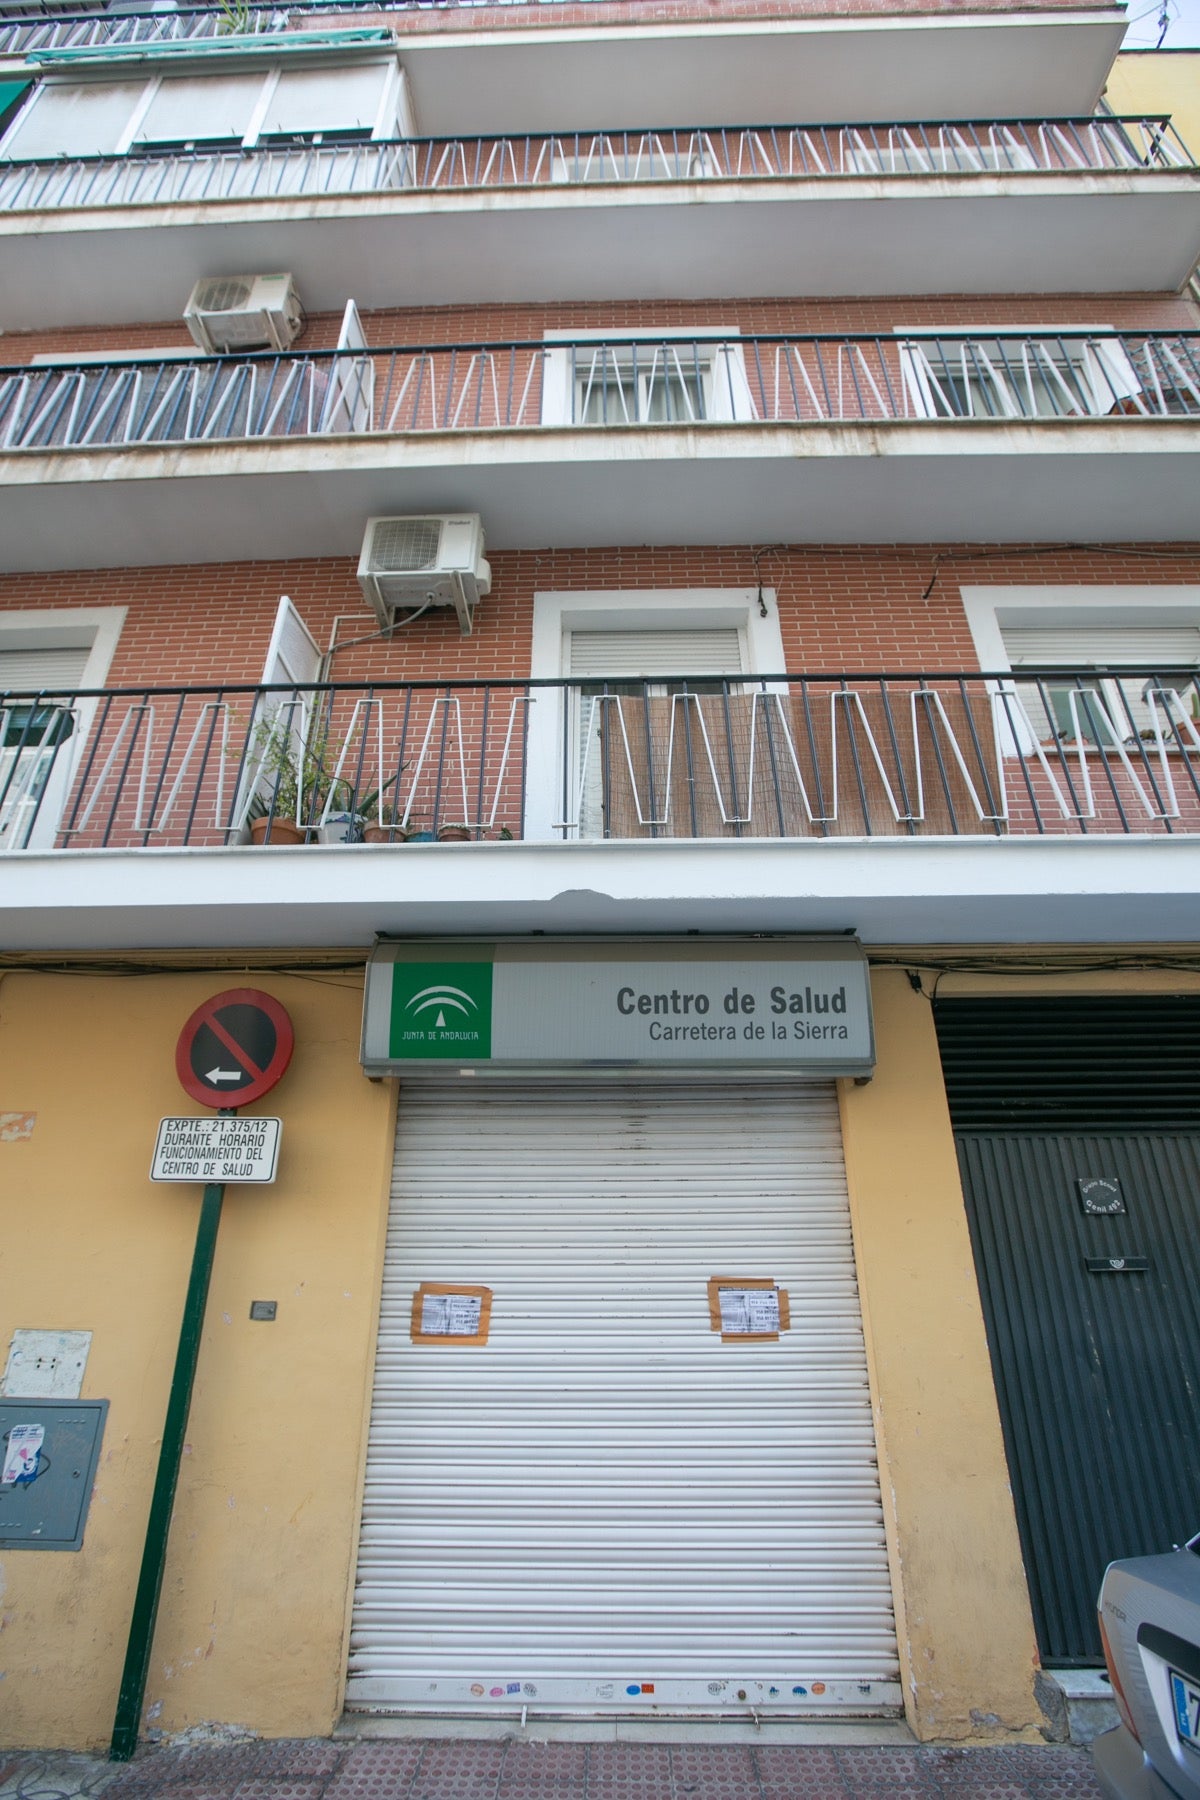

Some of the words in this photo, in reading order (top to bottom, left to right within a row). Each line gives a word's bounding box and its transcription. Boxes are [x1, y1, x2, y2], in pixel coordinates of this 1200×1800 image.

[617, 987, 710, 1015] Centro
[723, 987, 756, 1014] de
[770, 986, 847, 1014] Salud
[402, 1031, 425, 1041] JUNTA
[428, 1031, 437, 1041] DE
[649, 1021, 736, 1041] Carretera
[743, 1021, 765, 1040] de
[772, 1021, 787, 1040] la
[794, 1021, 848, 1040] Sierra
[166, 1120, 209, 1132] EXPTE.:
[212, 1121, 268, 1133] 21.375/12
[164, 1133, 213, 1146] DURANTE
[219, 1134, 265, 1147] HORARIO
[160, 1147, 242, 1160] FUNCIONAMIENTO
[246, 1148, 263, 1160] DEL
[162, 1162, 199, 1175] CENTRO
[203, 1163, 216, 1175] DE
[222, 1163, 253, 1176] SALUD
